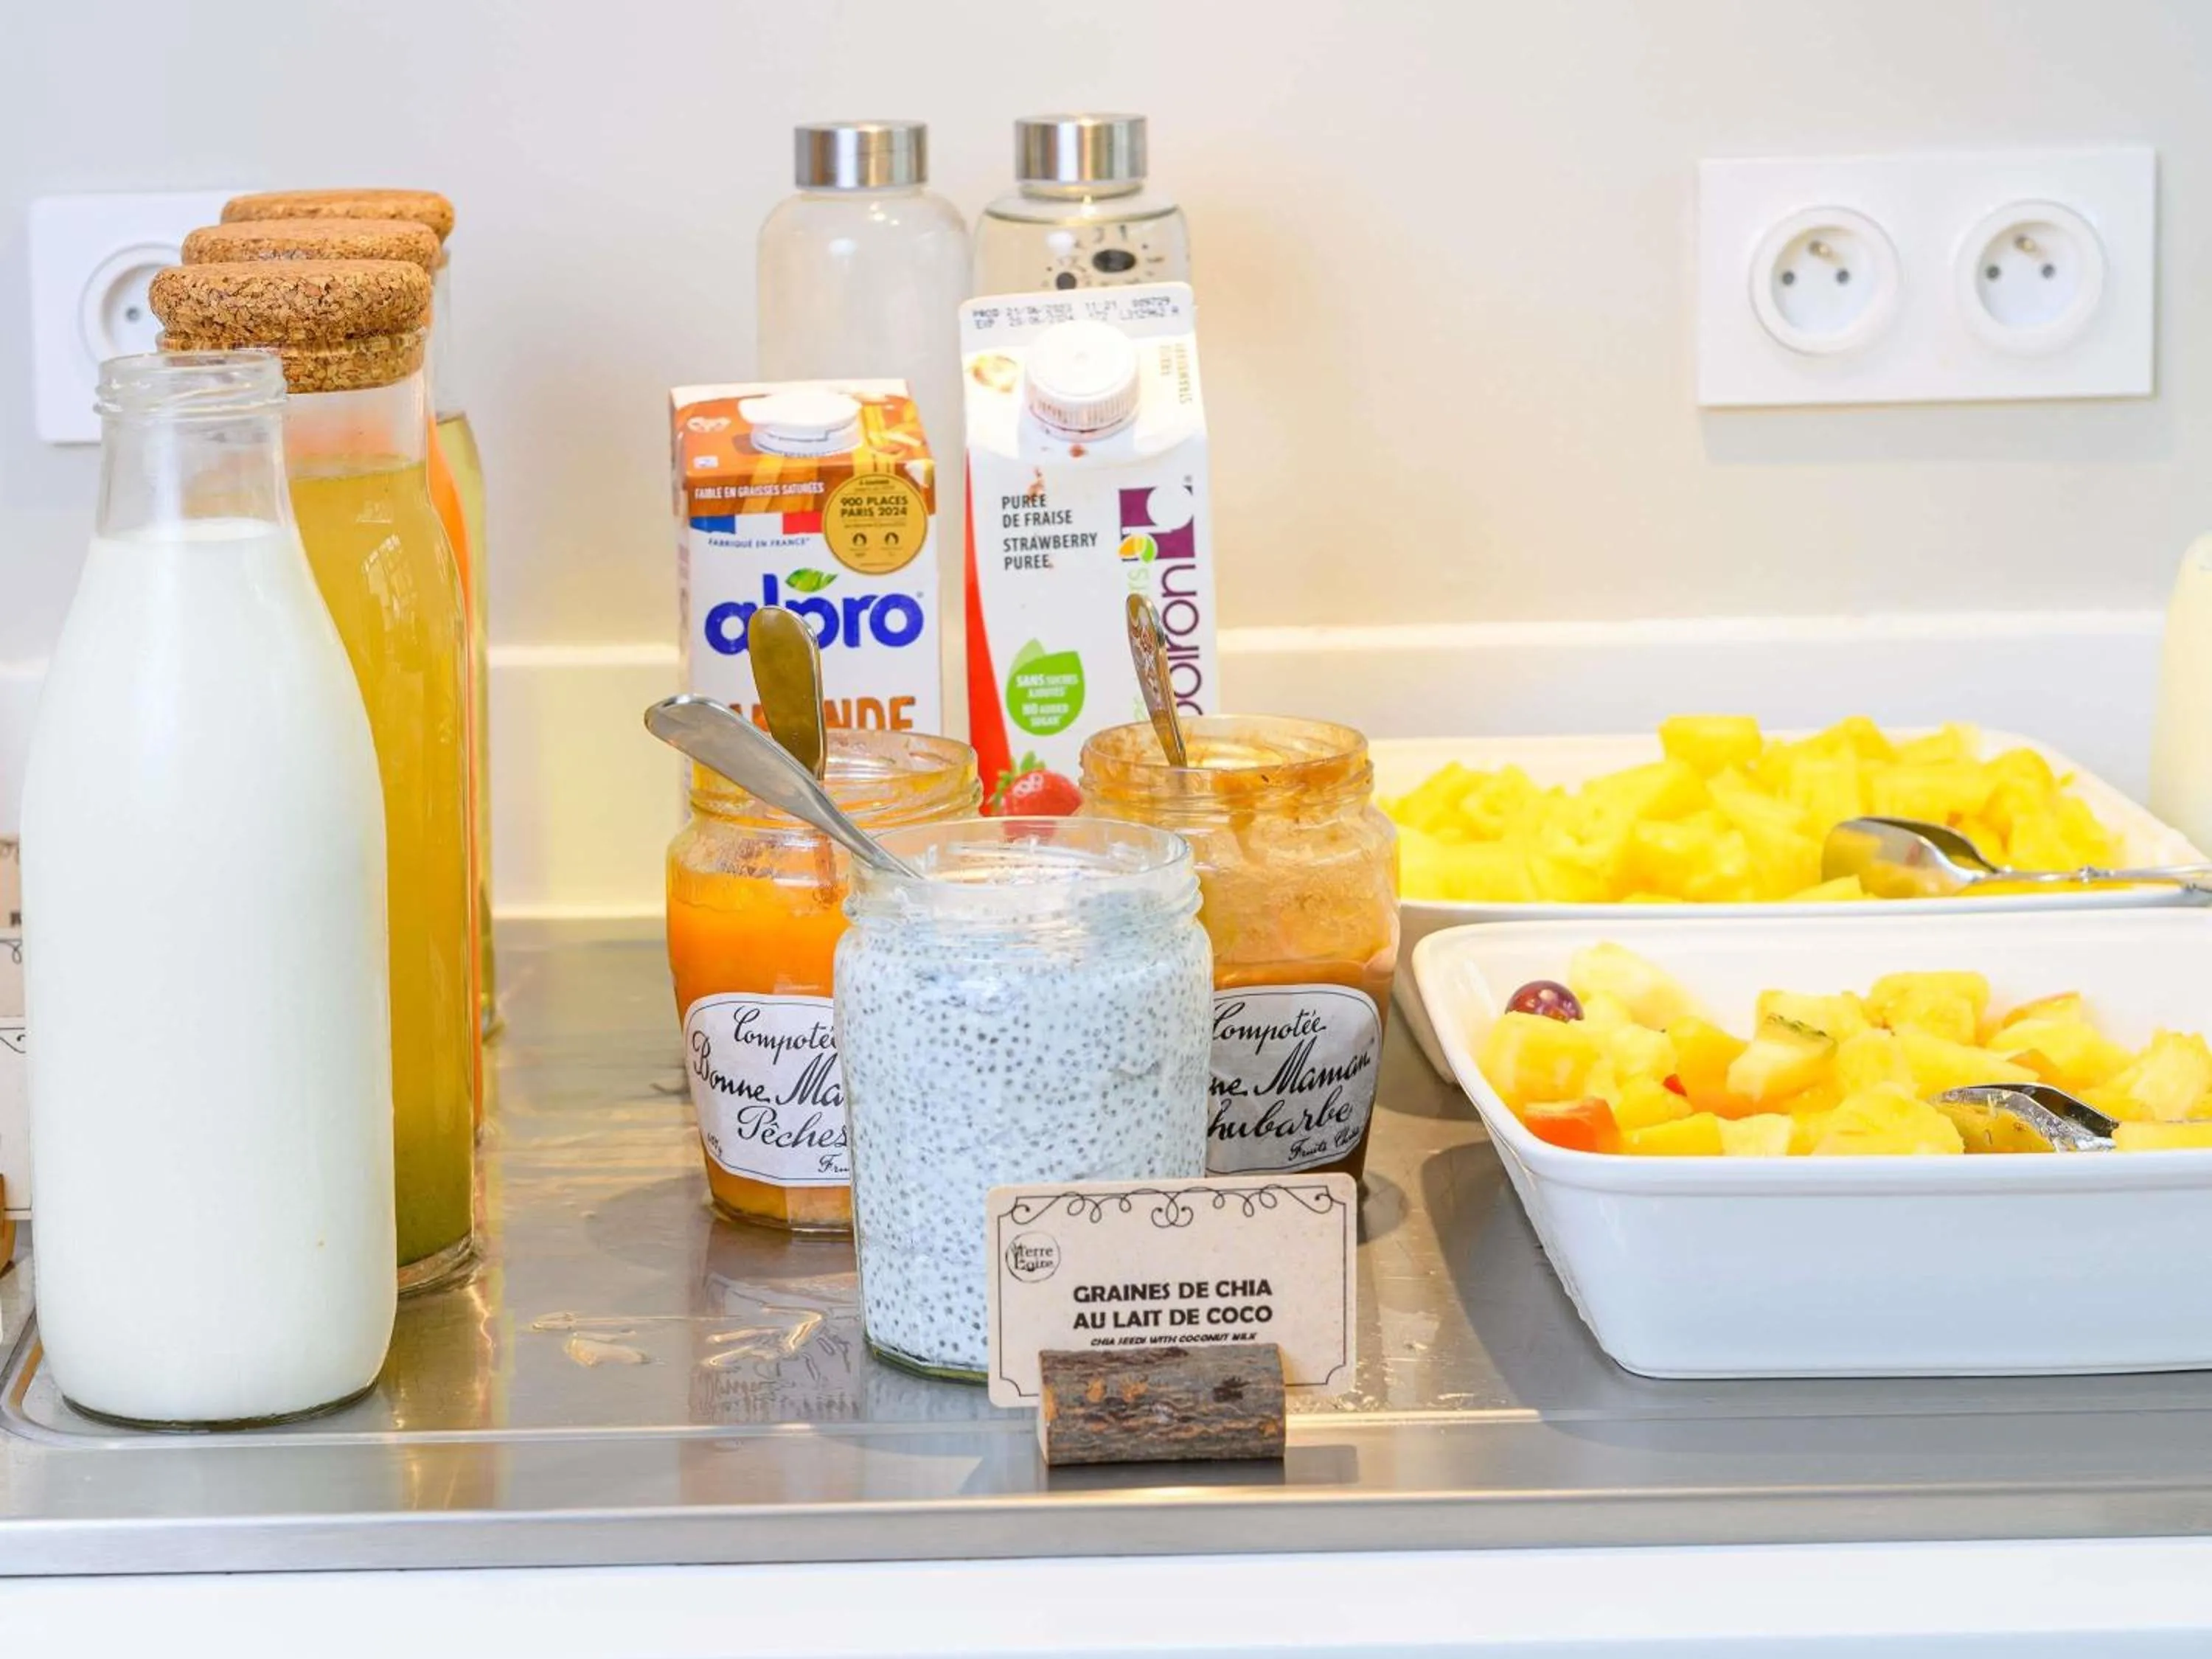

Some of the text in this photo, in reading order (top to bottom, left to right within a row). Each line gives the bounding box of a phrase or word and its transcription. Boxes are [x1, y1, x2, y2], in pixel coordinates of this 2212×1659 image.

[841, 495, 908, 506] 900 PLACES
[841, 507, 907, 517] PARIS 2024
[1003, 509, 1073, 529] DE FRAISE
[756, 540, 767, 548] EN
[1004, 532, 1097, 553] STRAWBERRY
[1161, 564, 1203, 716] oiron
[728, 695, 917, 732] NDE
[692, 1030, 770, 1103] Bonne
[1253, 1034, 1370, 1096] Maman
[1207, 1085, 1352, 1141] hubarbe
[737, 1105, 847, 1148] Pêches
[1073, 1279, 1273, 1303] GRAINES DE CHIA
[1073, 1305, 1273, 1329] AU LAIT DE COCO
[1091, 1338, 1114, 1346] CHIA
[1118, 1336, 1146, 1346] SEEDS
[1149, 1335, 1177, 1344] WITH
[1179, 1333, 1229, 1343] COCONUT
